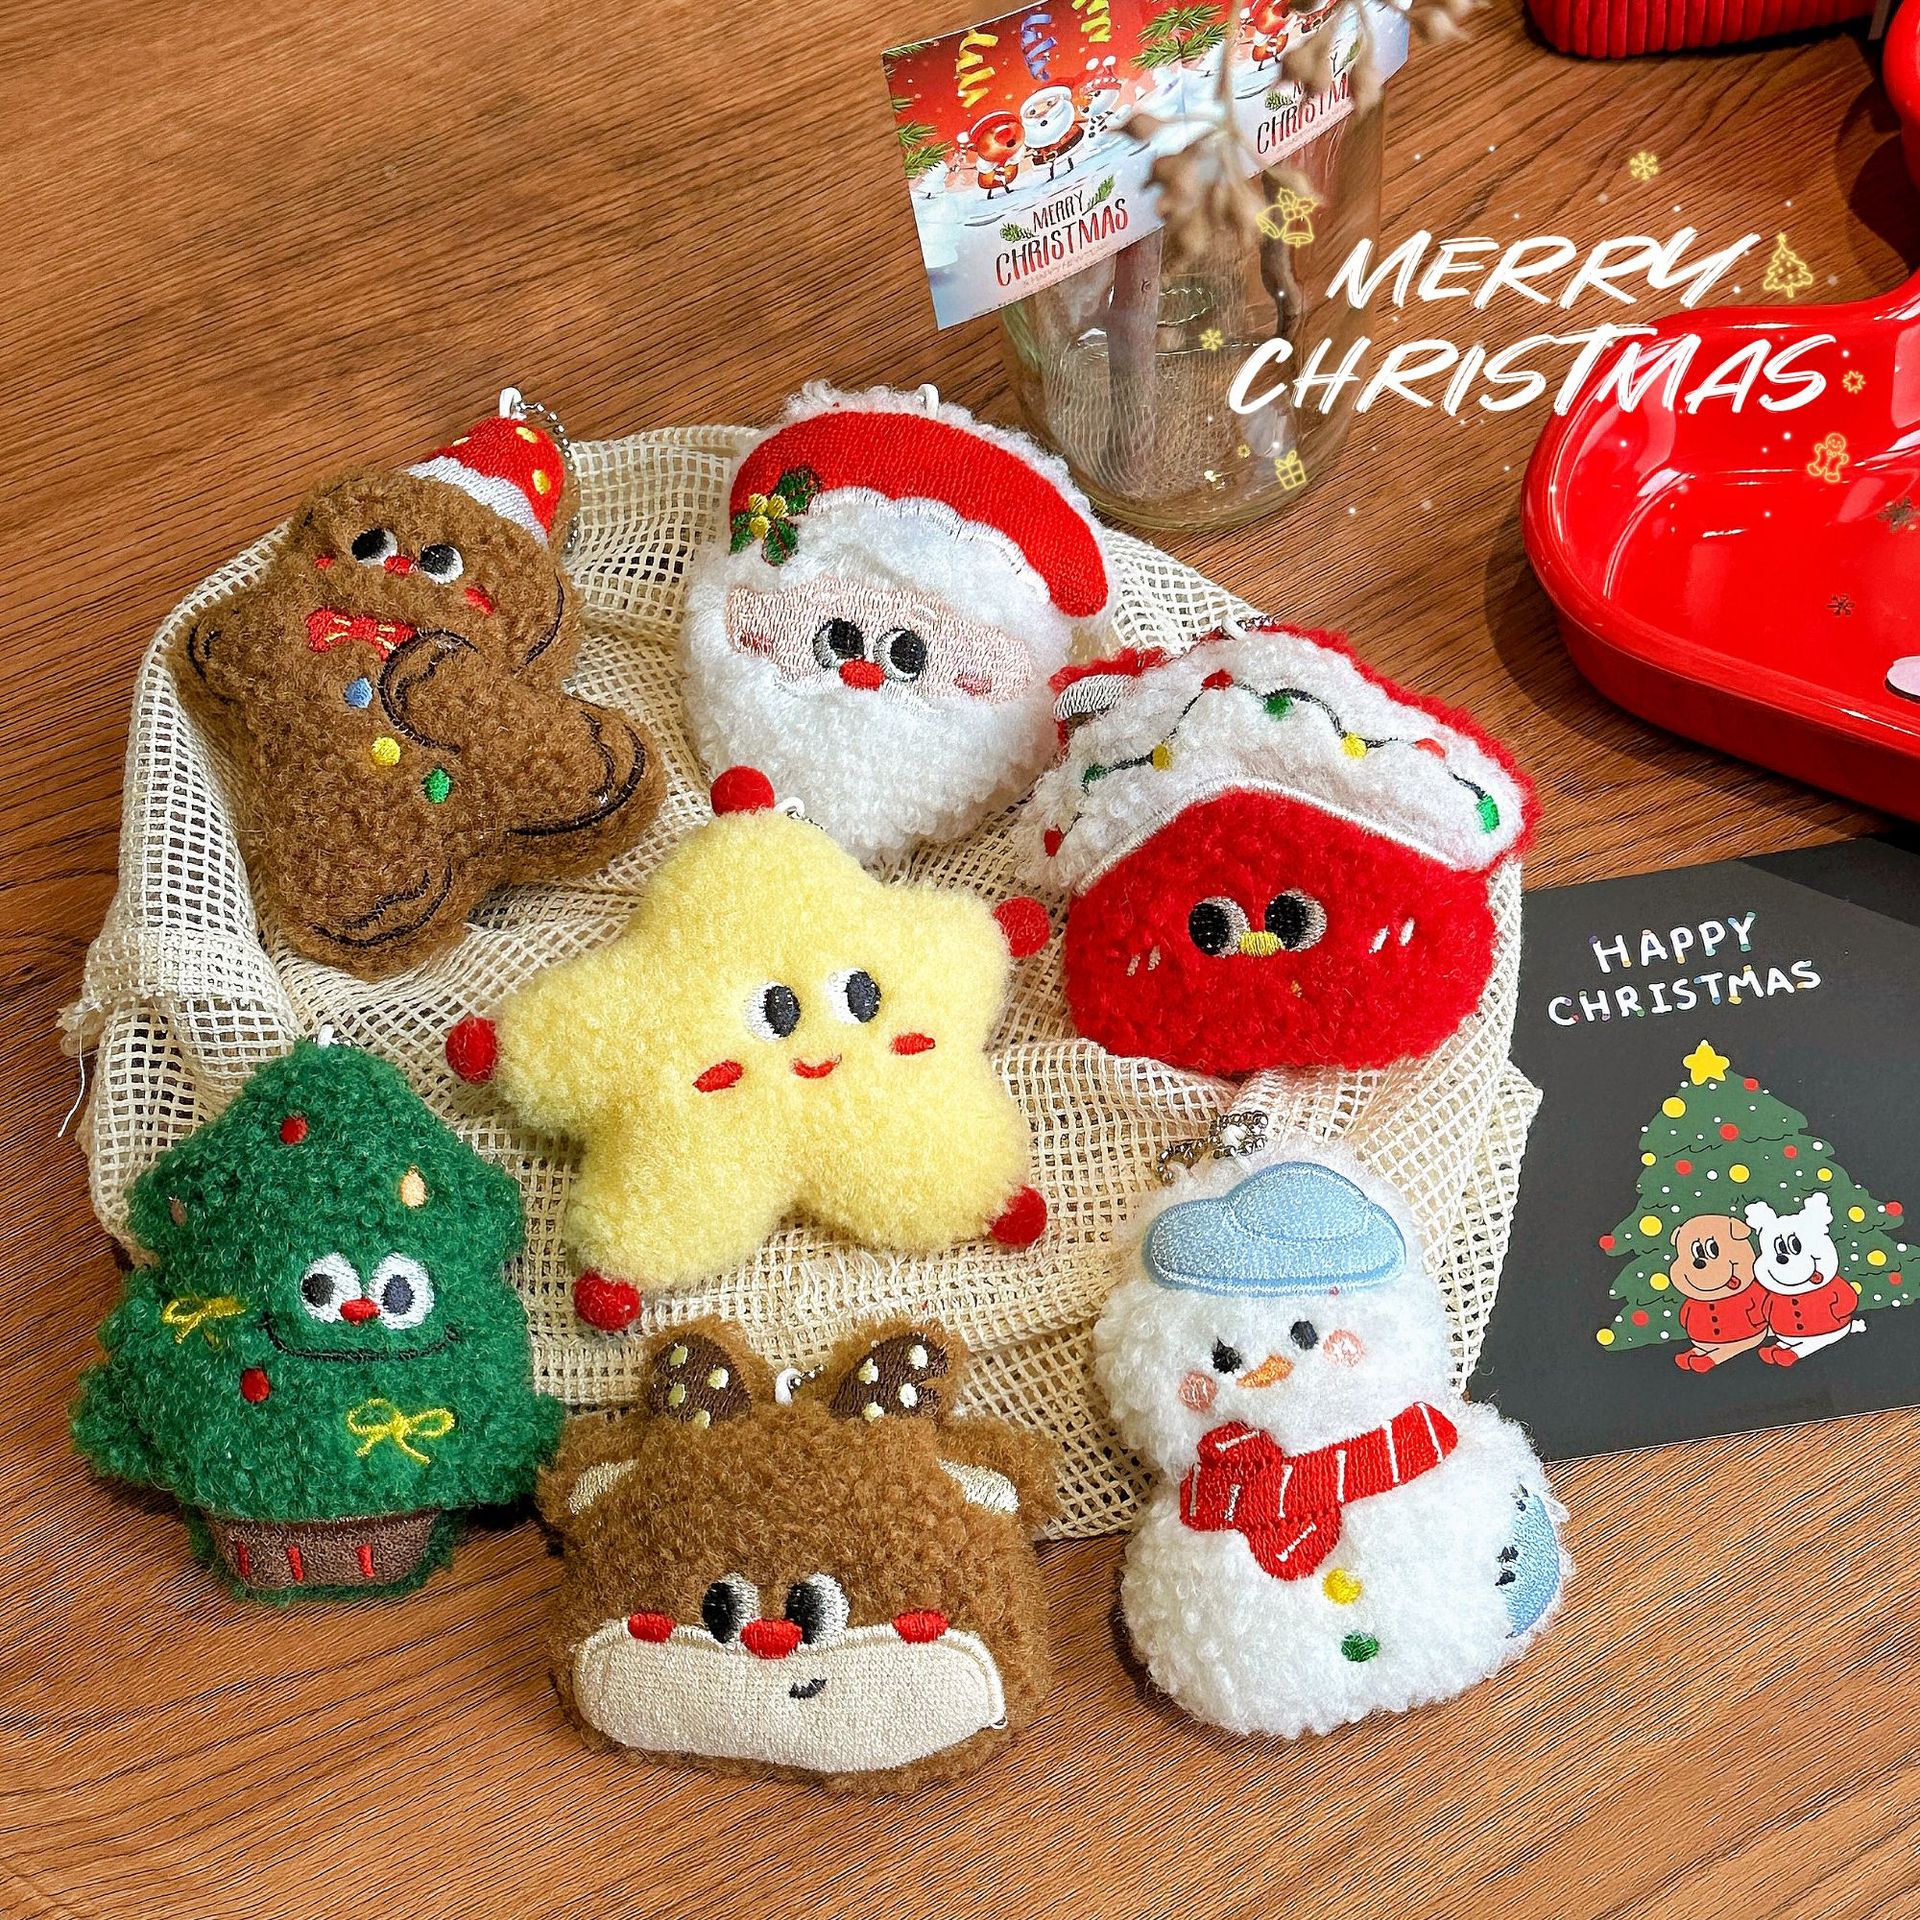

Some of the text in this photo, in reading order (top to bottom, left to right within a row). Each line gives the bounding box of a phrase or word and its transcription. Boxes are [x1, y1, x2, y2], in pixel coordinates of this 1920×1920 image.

[1256, 72, 1350, 155] CHRISTM
[995, 198, 1130, 287] CHRISTMAS
[1032, 189, 1083, 233] MERRY
[1588, 911, 1756, 974] HAPPY
[1547, 959, 1822, 1027] CHRISTMAS
